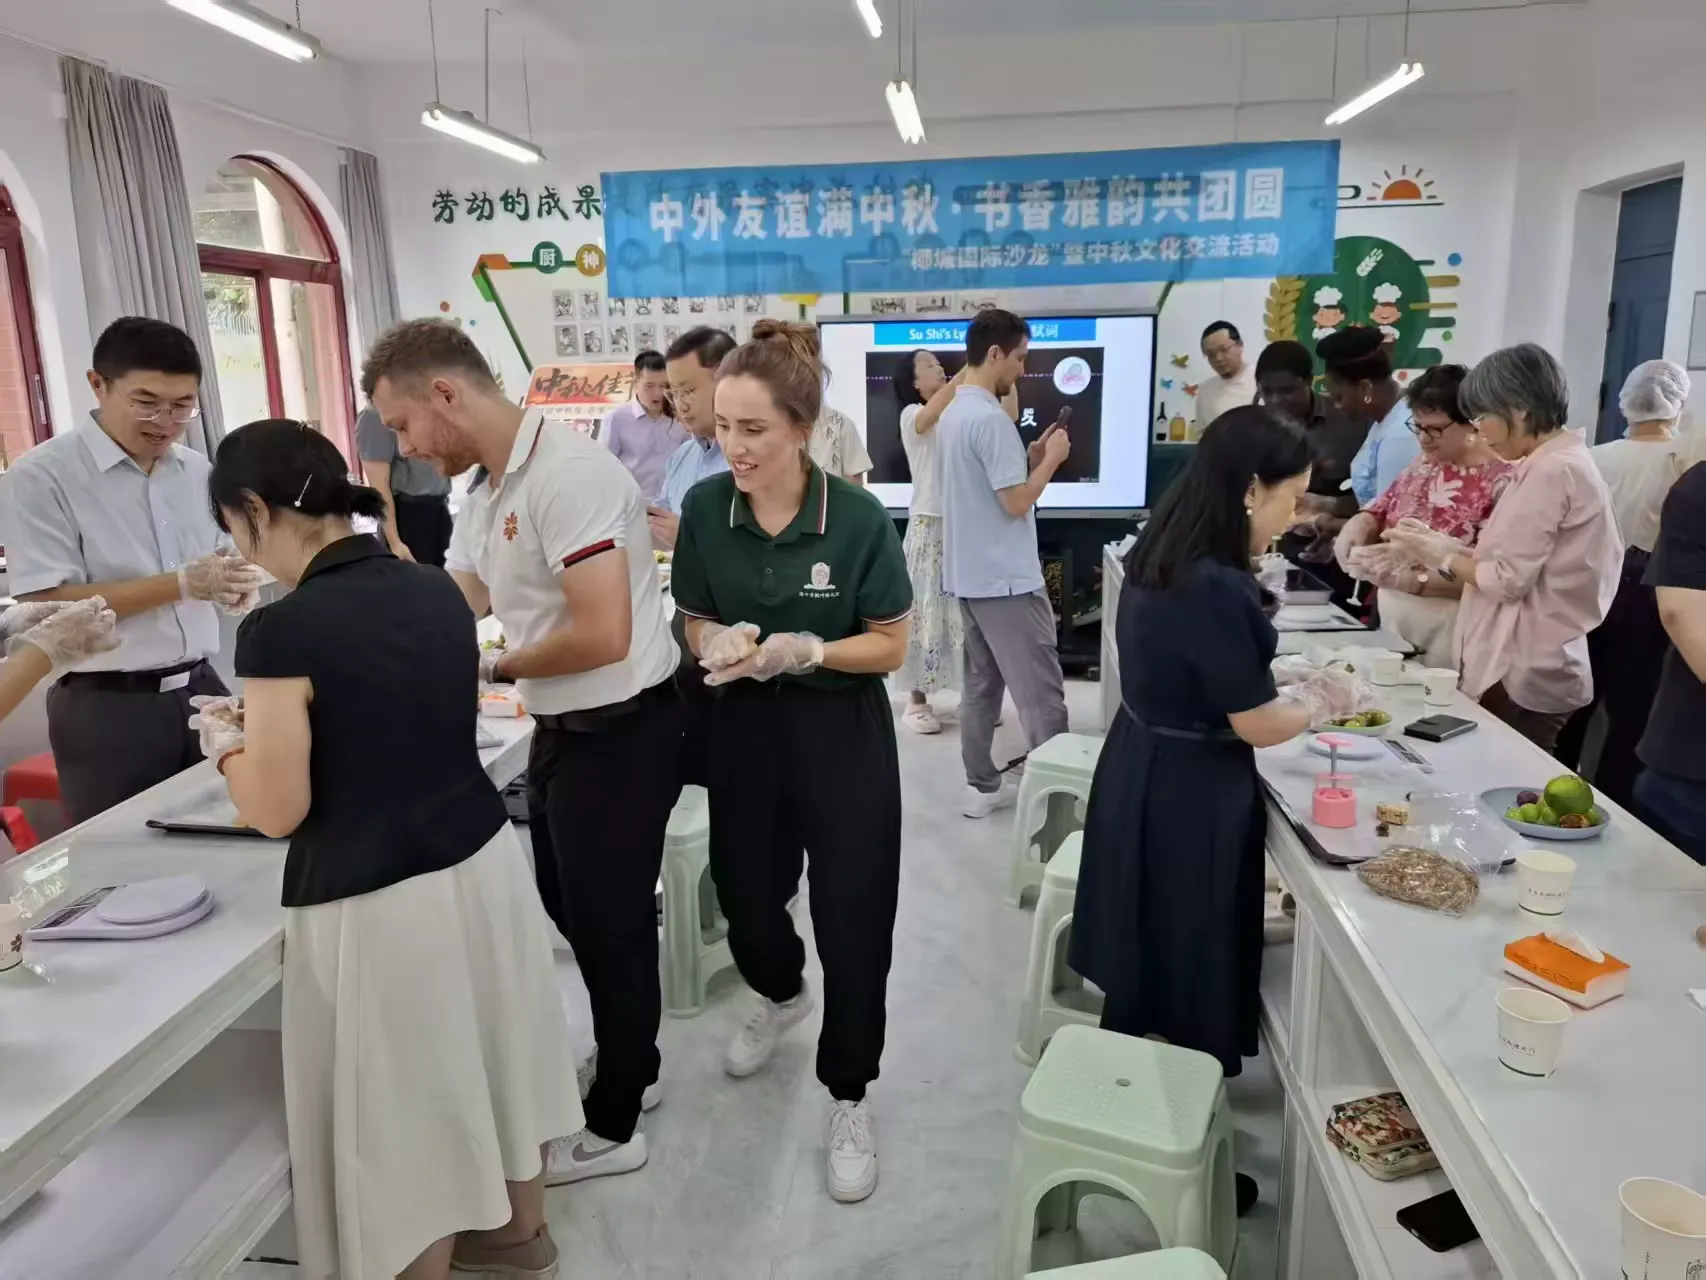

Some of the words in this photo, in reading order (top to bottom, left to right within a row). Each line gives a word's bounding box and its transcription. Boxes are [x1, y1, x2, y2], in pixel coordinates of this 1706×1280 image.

[649, 166, 1285, 243] 中外友谊满中秋·书香雅韵共团圆
[909, 327, 924, 341] Su
[926, 327, 951, 341] Shi's
[953, 327, 966, 341] Ly
